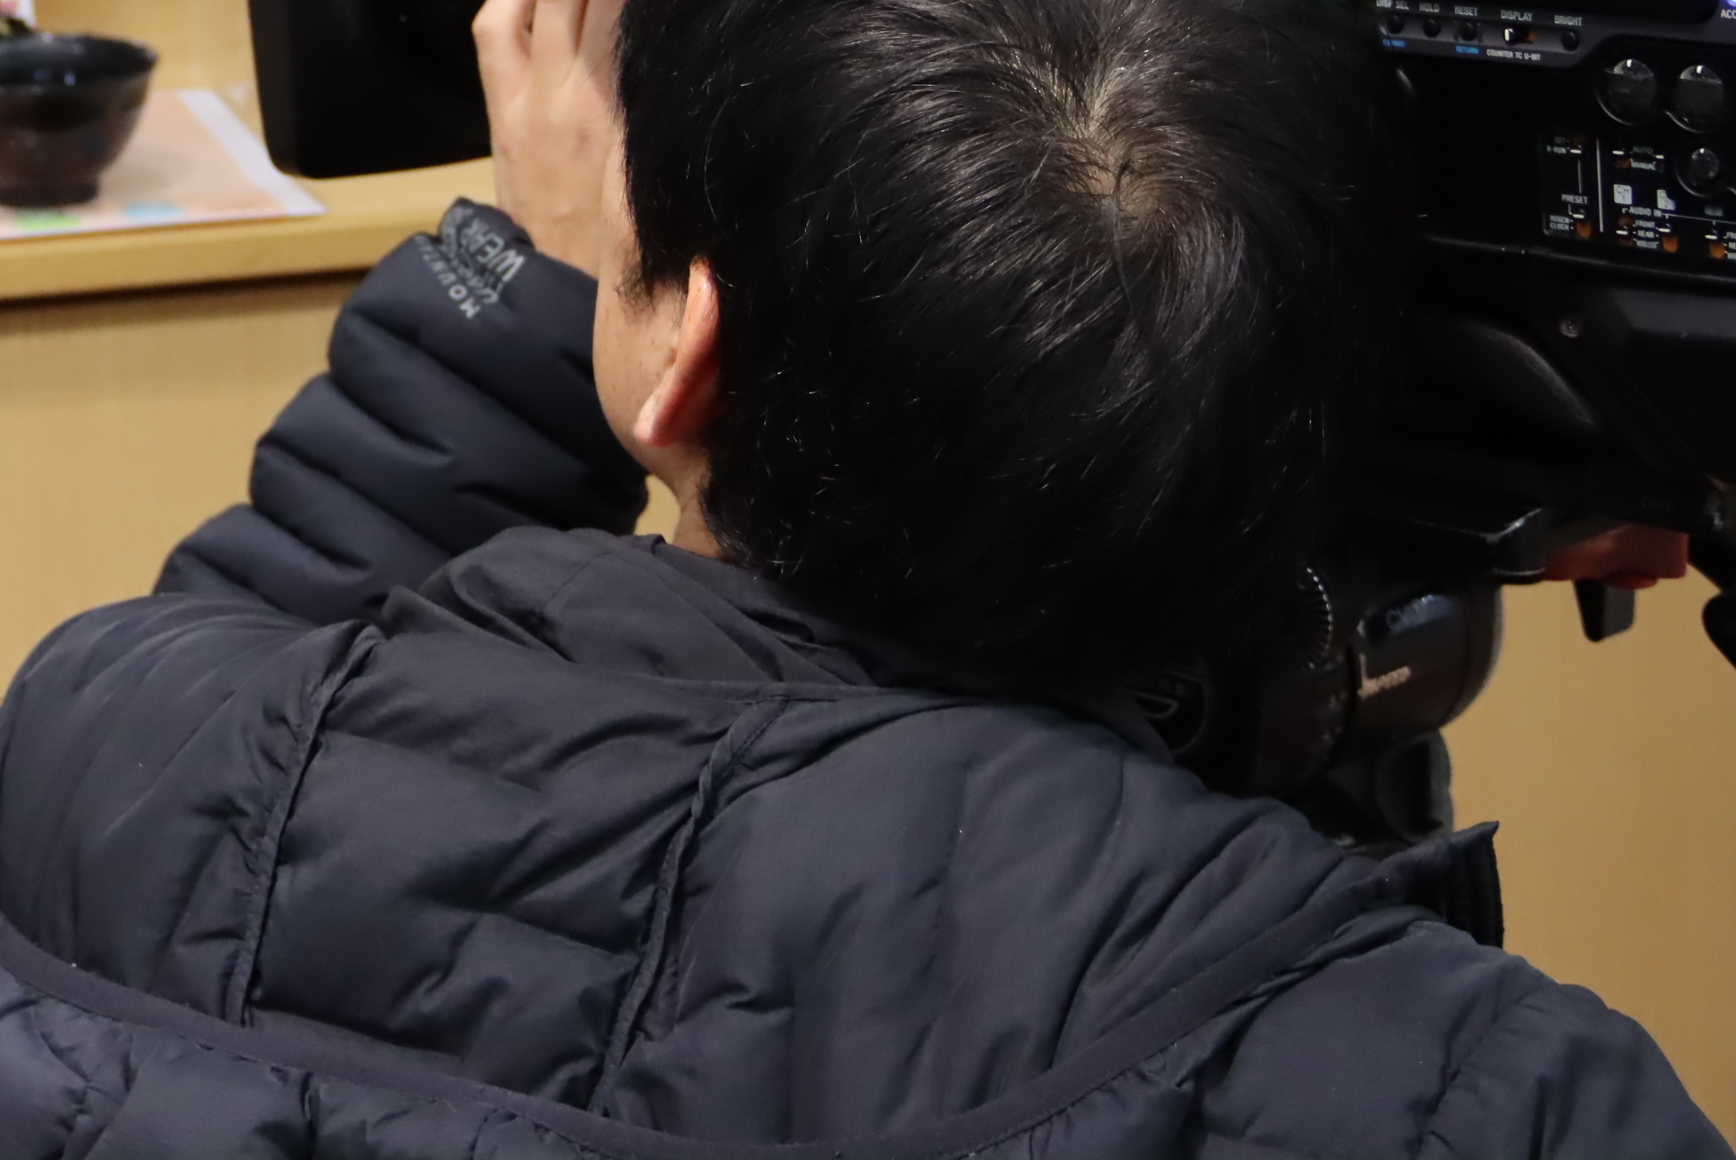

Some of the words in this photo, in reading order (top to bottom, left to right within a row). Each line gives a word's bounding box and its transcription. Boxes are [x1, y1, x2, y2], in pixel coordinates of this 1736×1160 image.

[1419, 2, 1440, 13] HOLD
[1454, 5, 1478, 17] RESET
[1500, 10, 1533, 22] DISPLAY
[1554, 15, 1583, 27] BRIGHT
[1486, 49, 1514, 58] COUNTER
[1633, 145, 1653, 154] AUTO
[1561, 194, 1588, 204] PRESET
